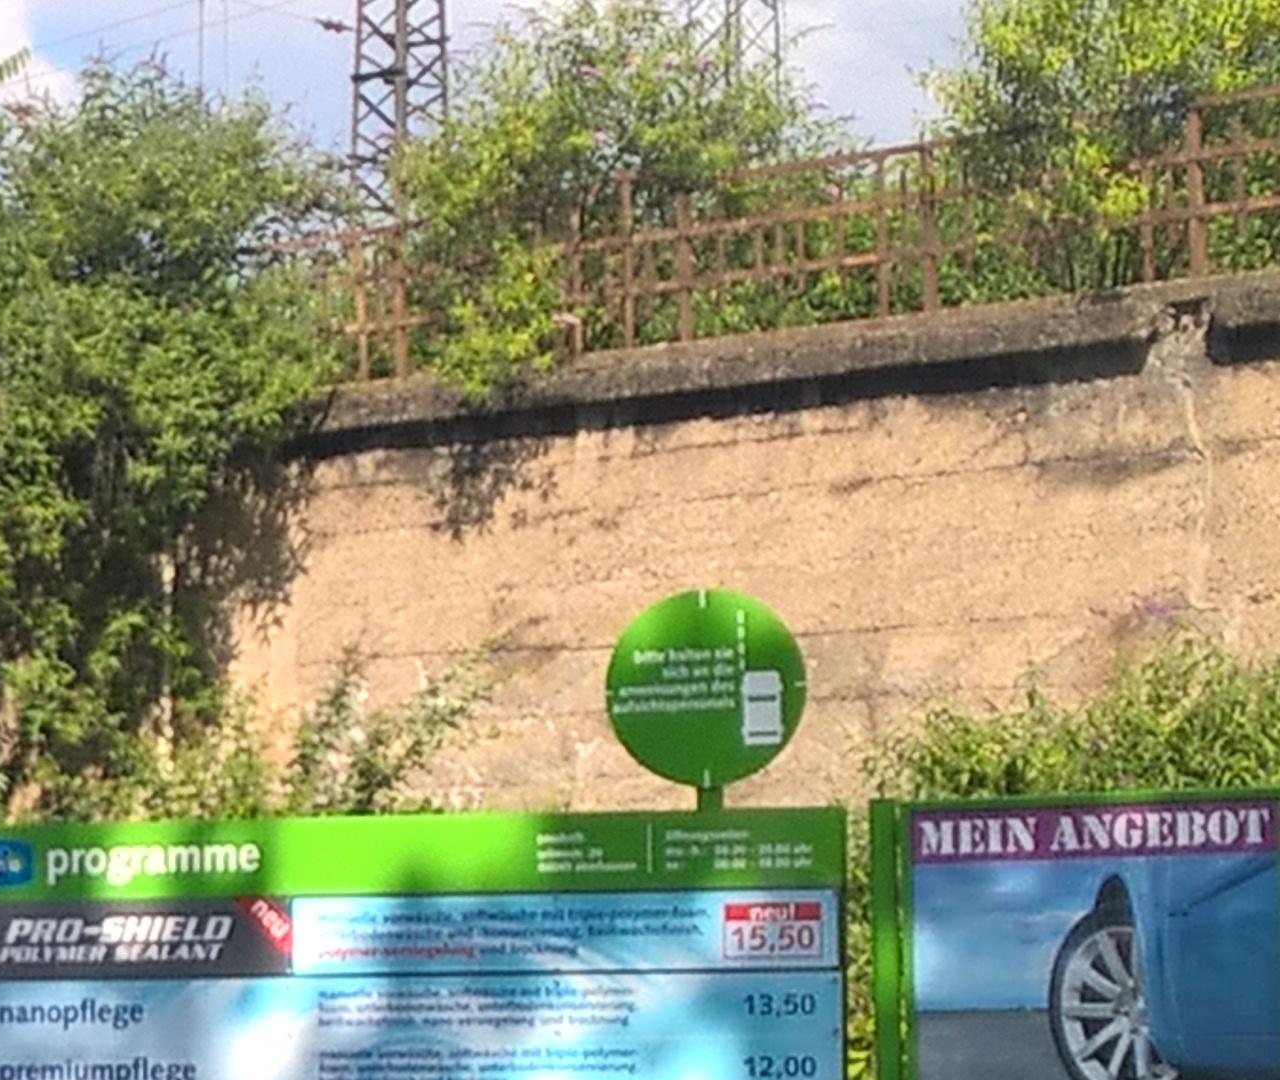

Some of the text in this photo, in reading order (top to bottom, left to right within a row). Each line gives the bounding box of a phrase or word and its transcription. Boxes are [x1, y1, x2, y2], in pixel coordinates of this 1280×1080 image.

[919, 808, 1270, 855] MEIN ANGEBOT
[47, 842, 261, 886] programme
[251, 898, 289, 937] neu
[749, 904, 796, 921] neu!
[5, 915, 233, 943] PRO-SHIELD
[731, 925, 815, 953] 15,50
[114, 943, 223, 961] SEALANT
[744, 993, 816, 1018] 13,50
[744, 1056, 817, 1079] 12,00
